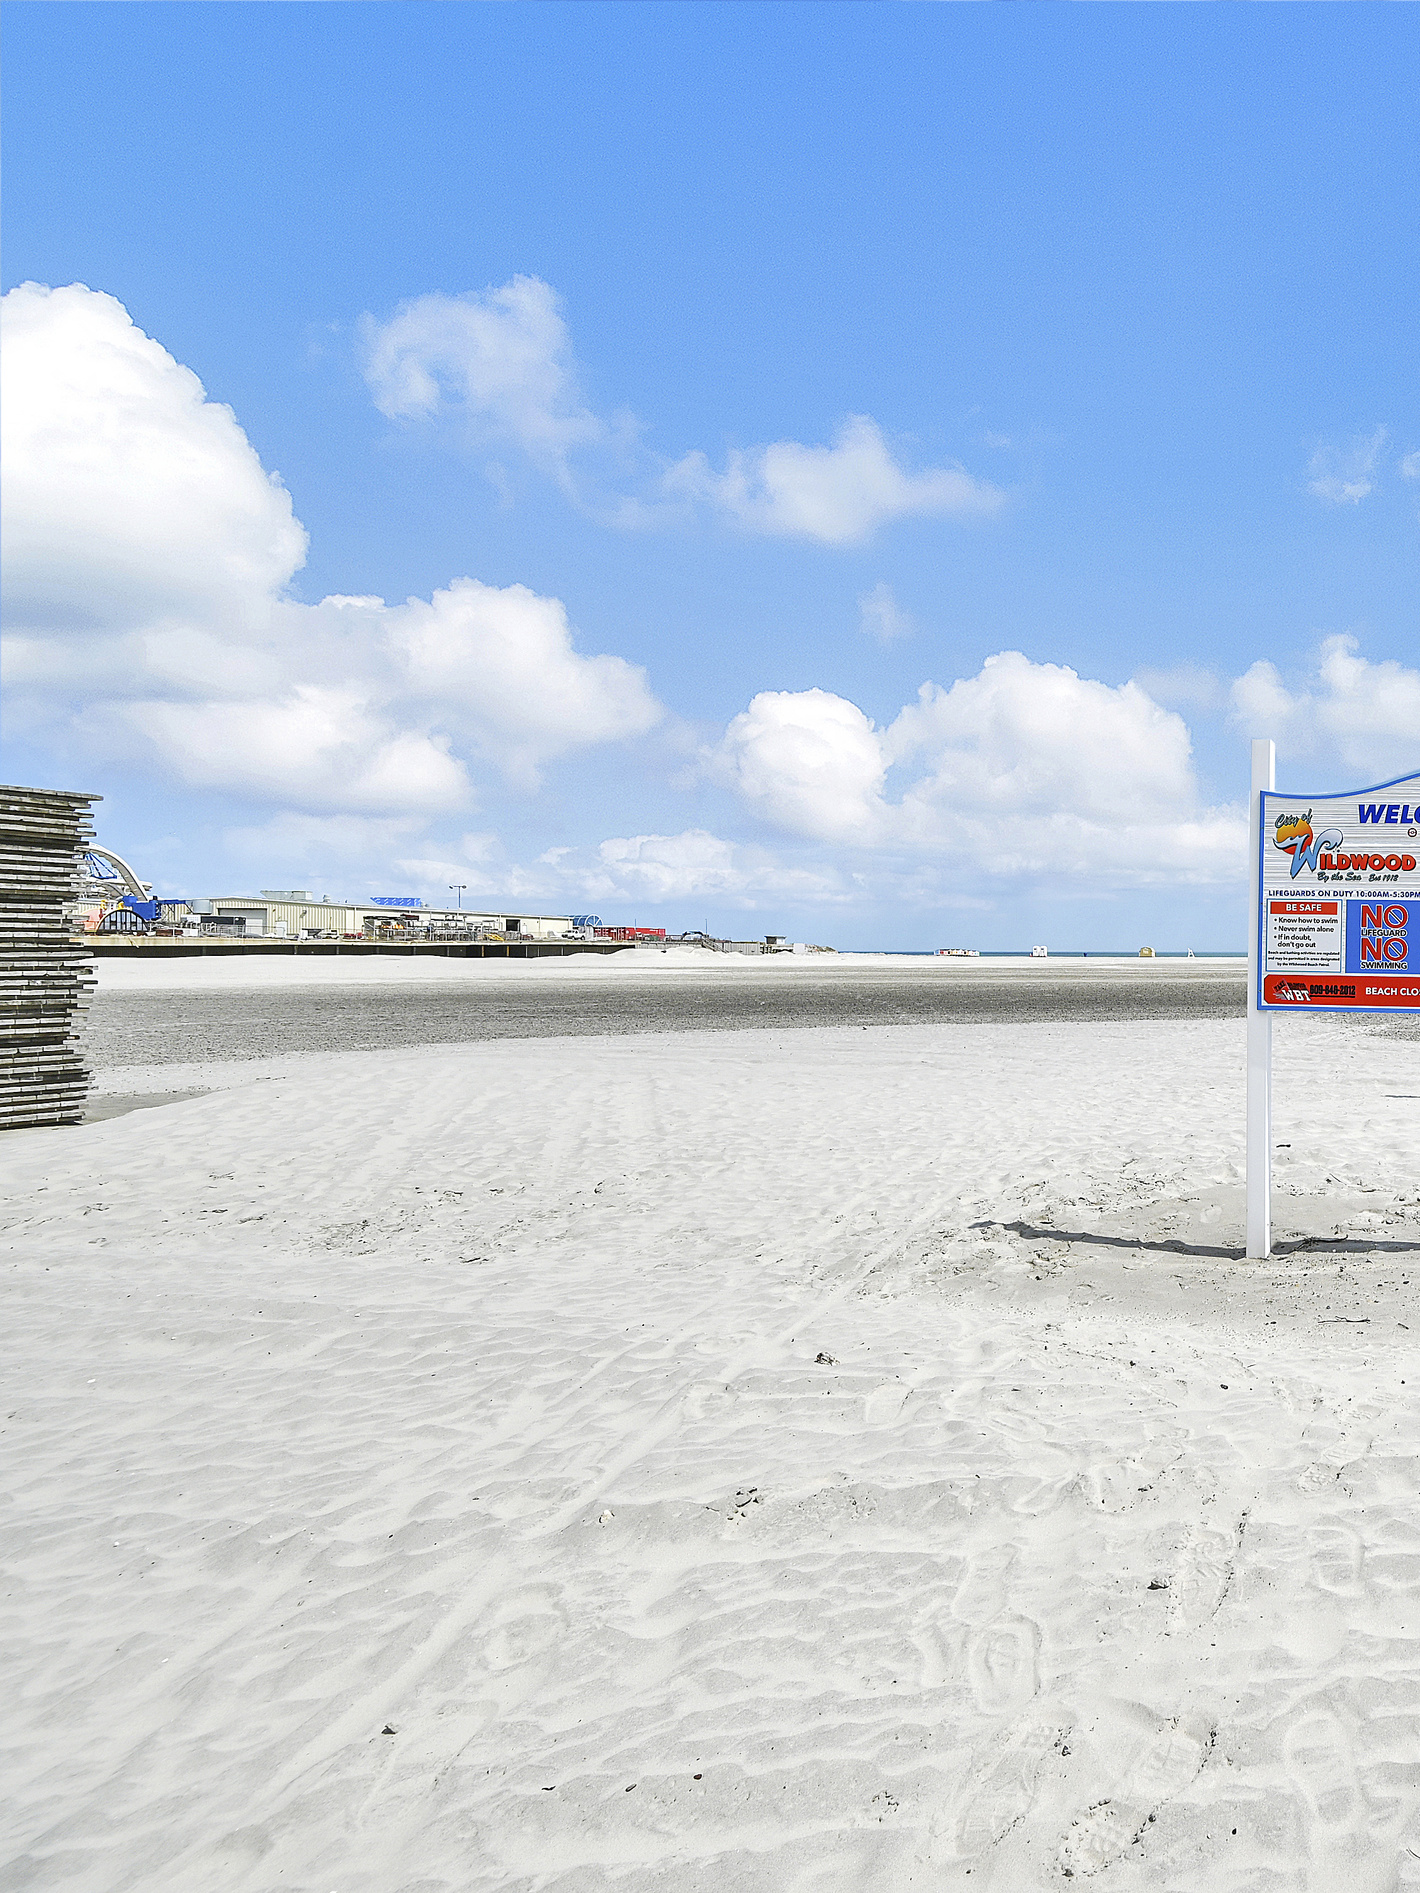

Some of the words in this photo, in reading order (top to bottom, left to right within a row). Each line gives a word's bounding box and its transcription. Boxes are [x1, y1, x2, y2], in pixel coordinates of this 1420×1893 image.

[1275, 813, 1299, 828] City
[1302, 808, 1313, 824] of
[1273, 828, 1417, 880] WILDWOOD
[1317, 871, 1329, 883] By
[1331, 871, 1344, 881] the
[1345, 871, 1362, 881] Sea
[1299, 904, 1322, 912] SAFE
[1361, 904, 1408, 929] NO
[1361, 937, 1408, 962] NO
[1281, 989, 1311, 1001] WBT
[1366, 987, 1398, 995] BEACH
